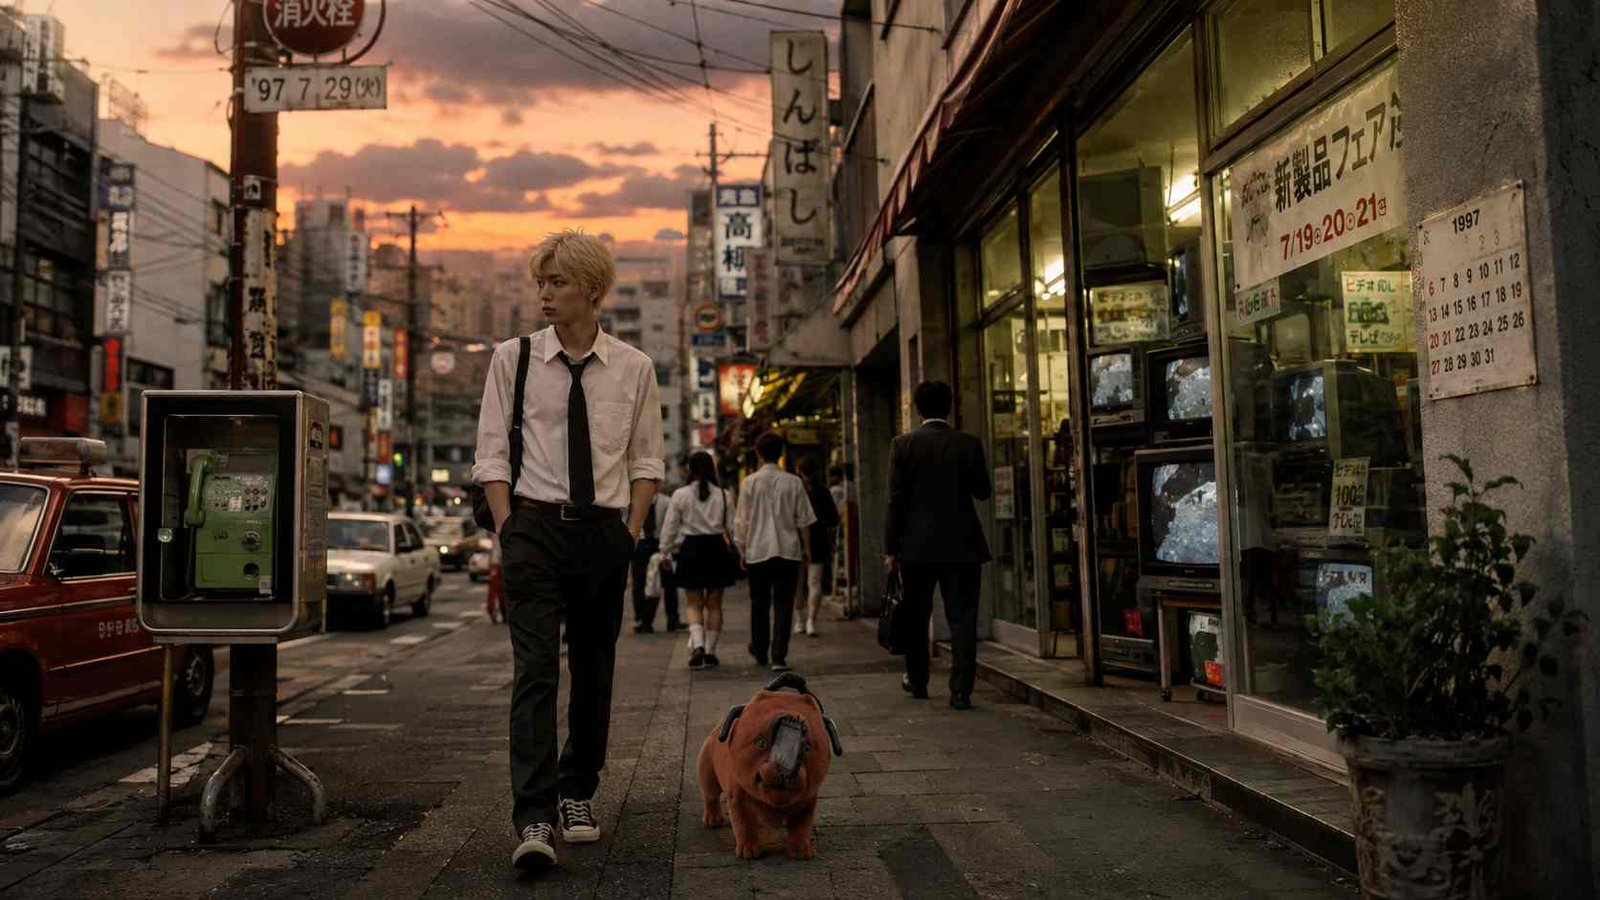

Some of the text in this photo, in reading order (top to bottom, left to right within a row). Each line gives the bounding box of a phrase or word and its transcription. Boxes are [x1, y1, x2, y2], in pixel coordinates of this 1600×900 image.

[274, 0, 356, 28] 消火栓
[298, 78, 311, 100] 7
[1452, 208, 1480, 234] 1997
[1428, 252, 1520, 297] 6 7 8 9 10 11 12
[1428, 281, 1522, 323] 13 14 15 16 17 18 19
[1429, 311, 1525, 349] 20 21 22 23 24 25 26
[1431, 347, 1495, 376] 27 28 29 30 31
